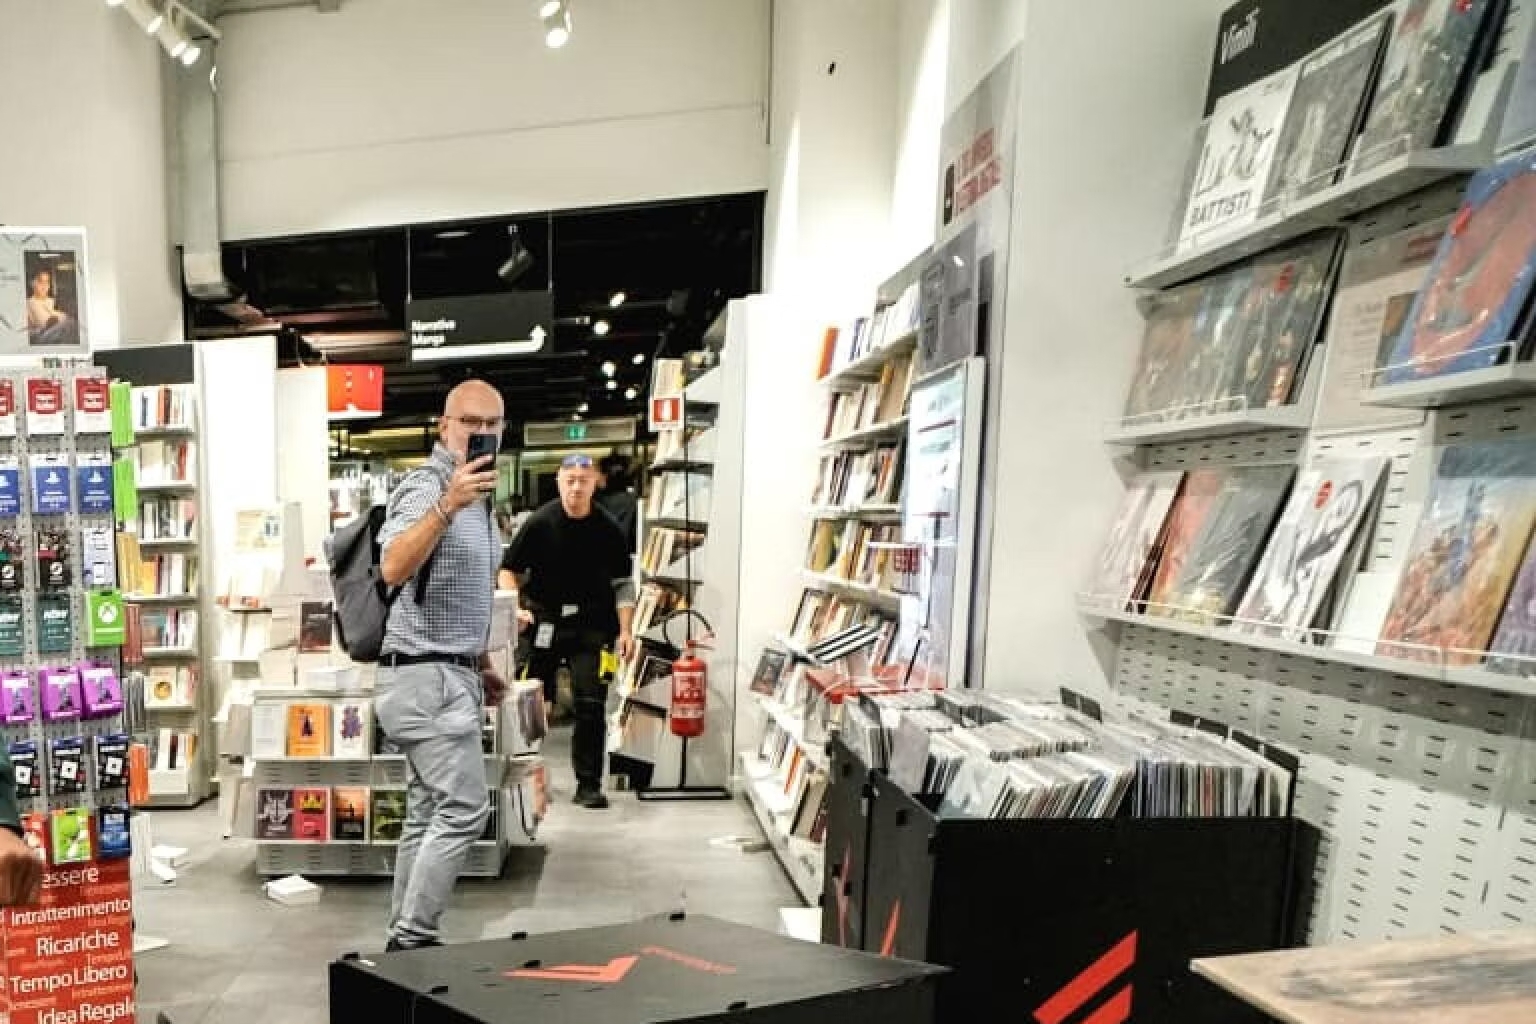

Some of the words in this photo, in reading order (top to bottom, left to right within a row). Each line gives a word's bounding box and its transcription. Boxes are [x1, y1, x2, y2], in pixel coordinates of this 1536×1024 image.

[41, 865, 100, 889] essere
[11, 899, 131, 927] Intrattenimento
[36, 929, 120, 957] Ricariche
[9, 972, 73, 993] Tempo
[73, 963, 128, 986] Libero
